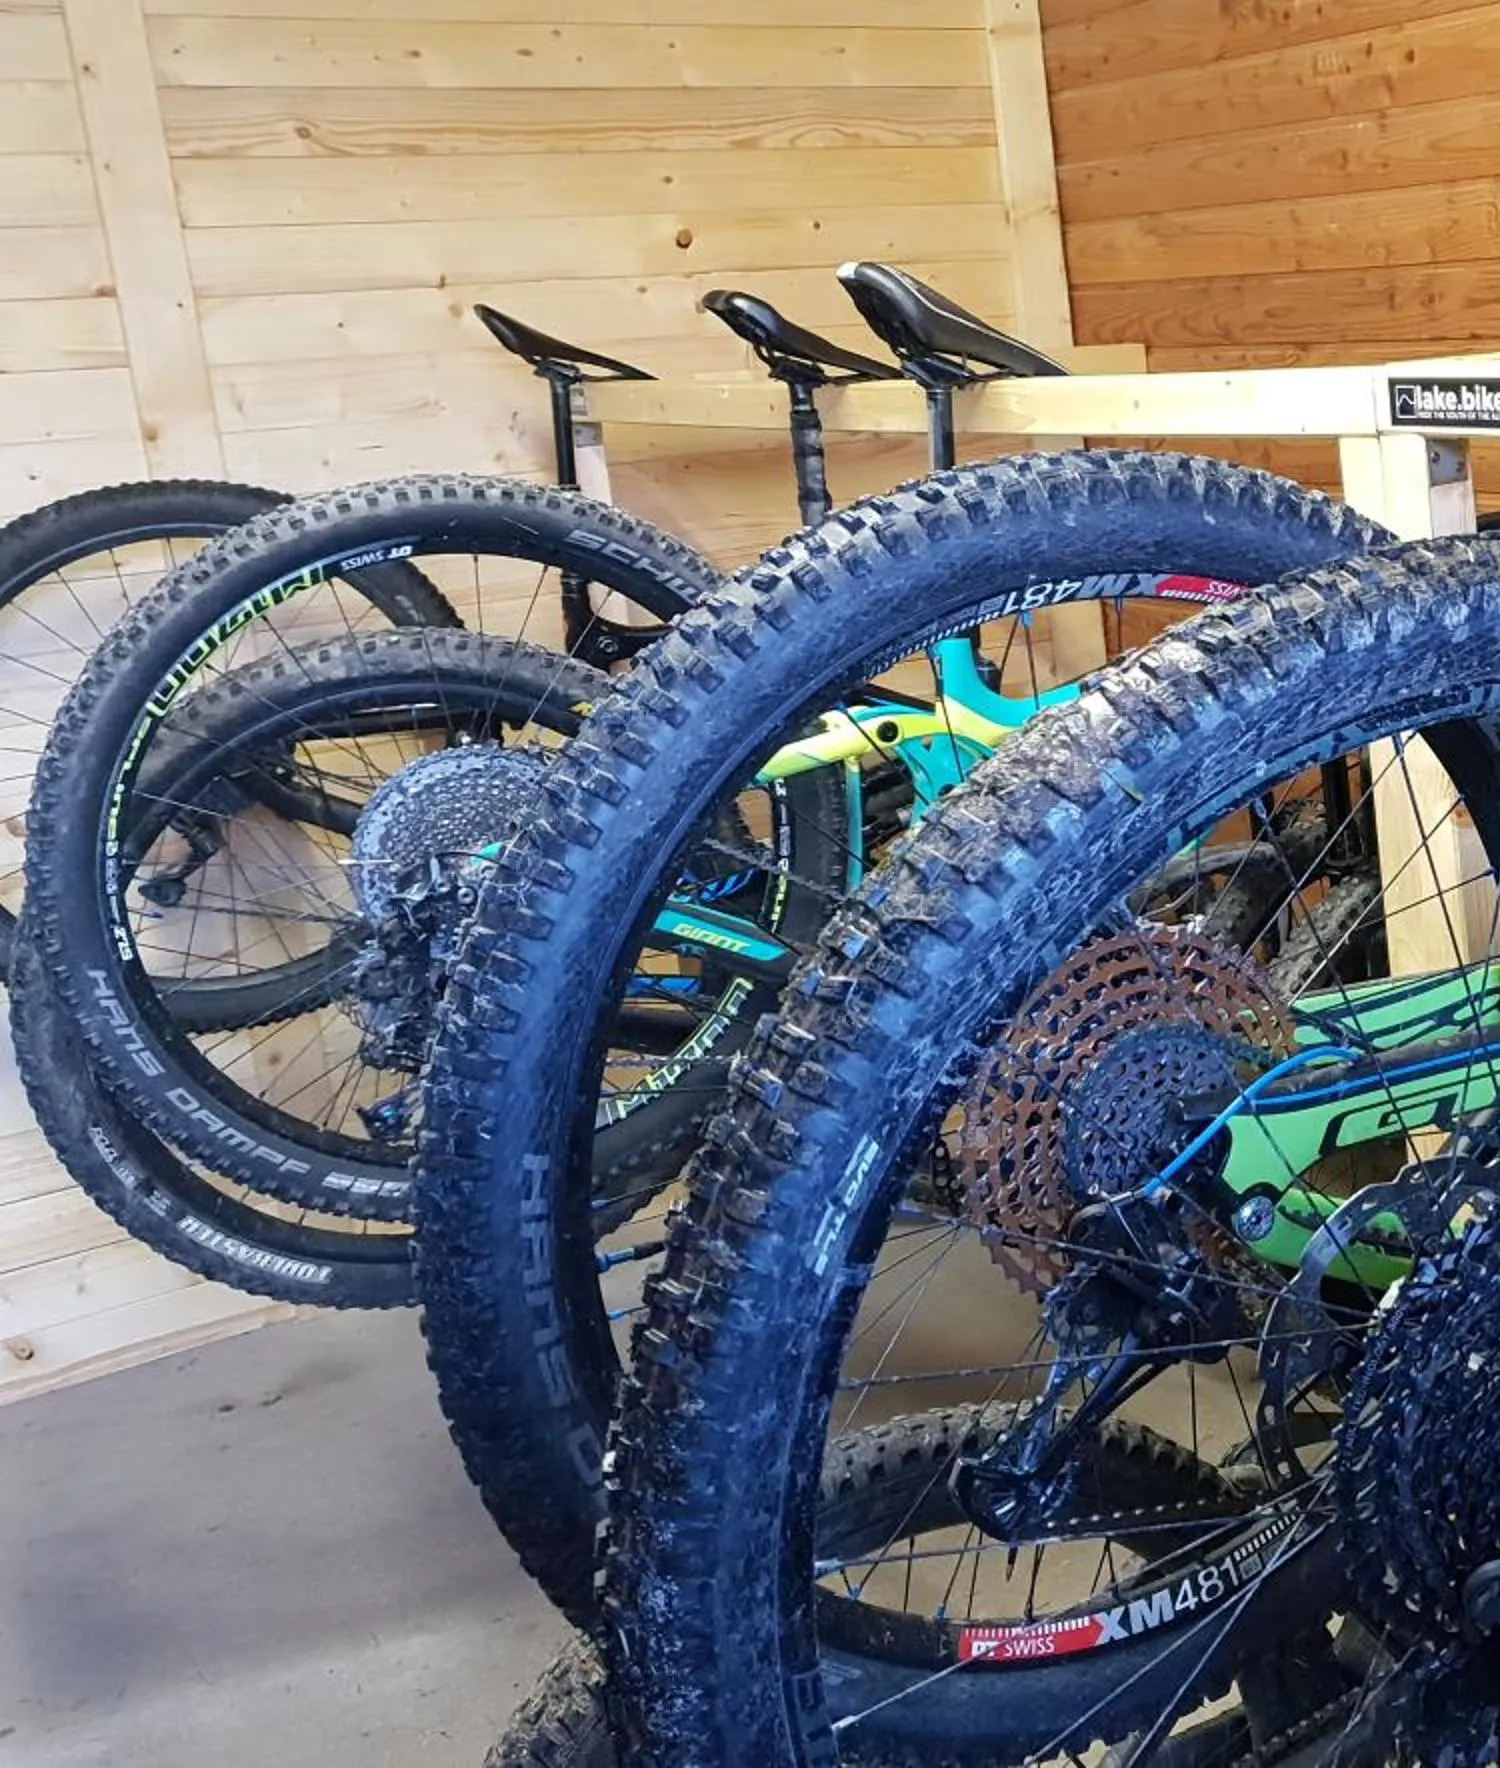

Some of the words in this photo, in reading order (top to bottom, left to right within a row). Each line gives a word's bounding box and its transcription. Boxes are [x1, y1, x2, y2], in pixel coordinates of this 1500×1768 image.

[340, 549, 383, 571] SWISS
[388, 545, 413, 559] DT
[165, 1087, 312, 1175] DAMPF
[1003, 1635, 1056, 1657] SWISS
